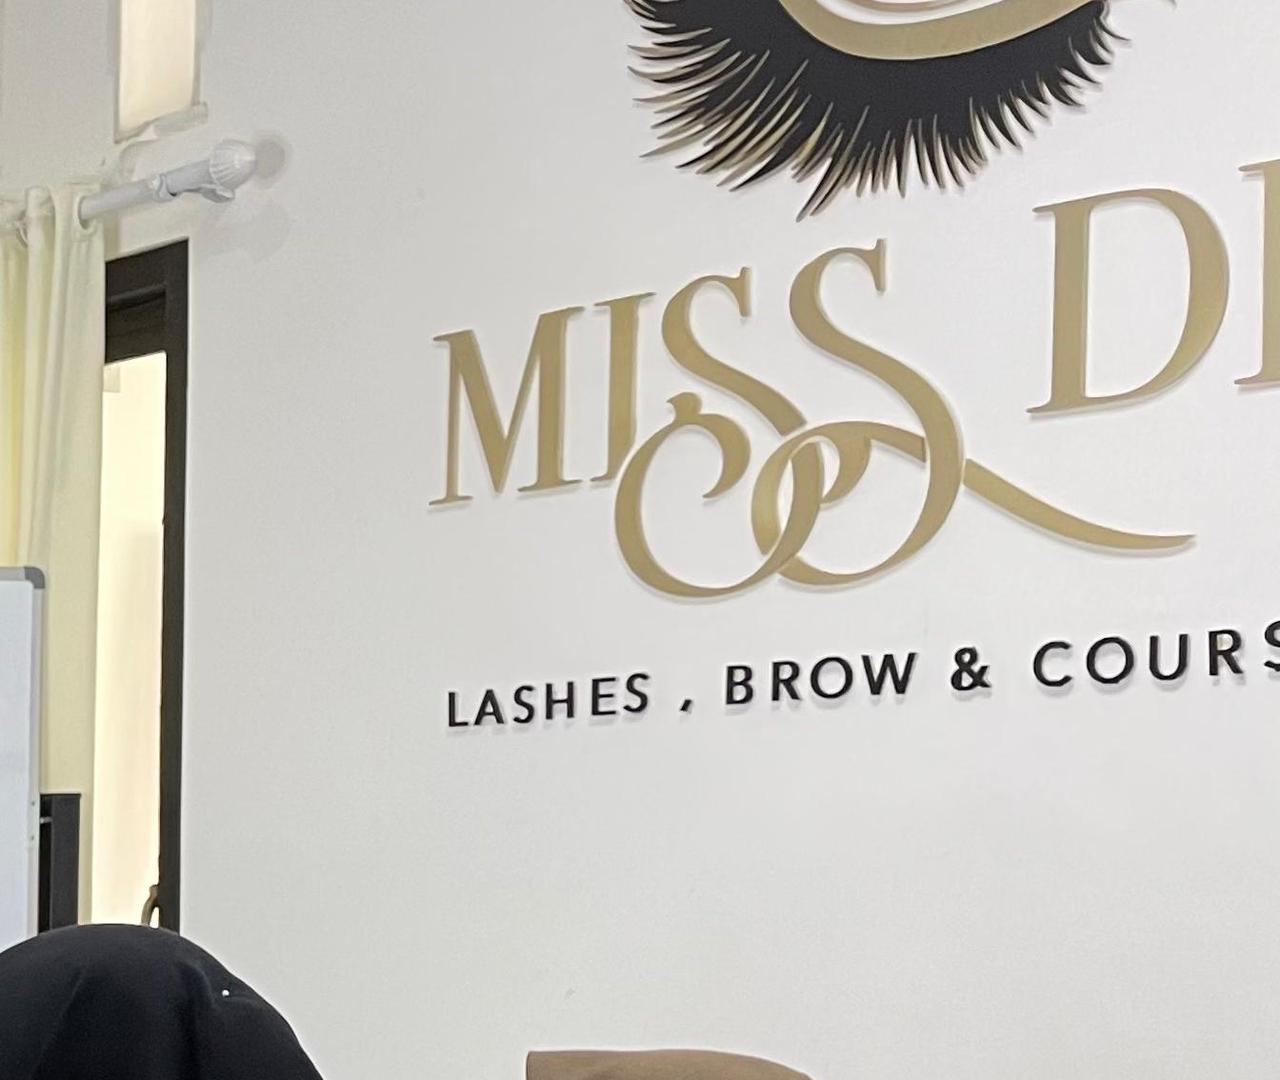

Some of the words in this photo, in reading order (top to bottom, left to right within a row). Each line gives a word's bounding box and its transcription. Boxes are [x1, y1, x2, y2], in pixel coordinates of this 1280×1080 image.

[428, 237, 1197, 600] MISS
[446, 672, 652, 729] LASHES
[723, 650, 919, 707] BROW
[950, 645, 993, 691] &
